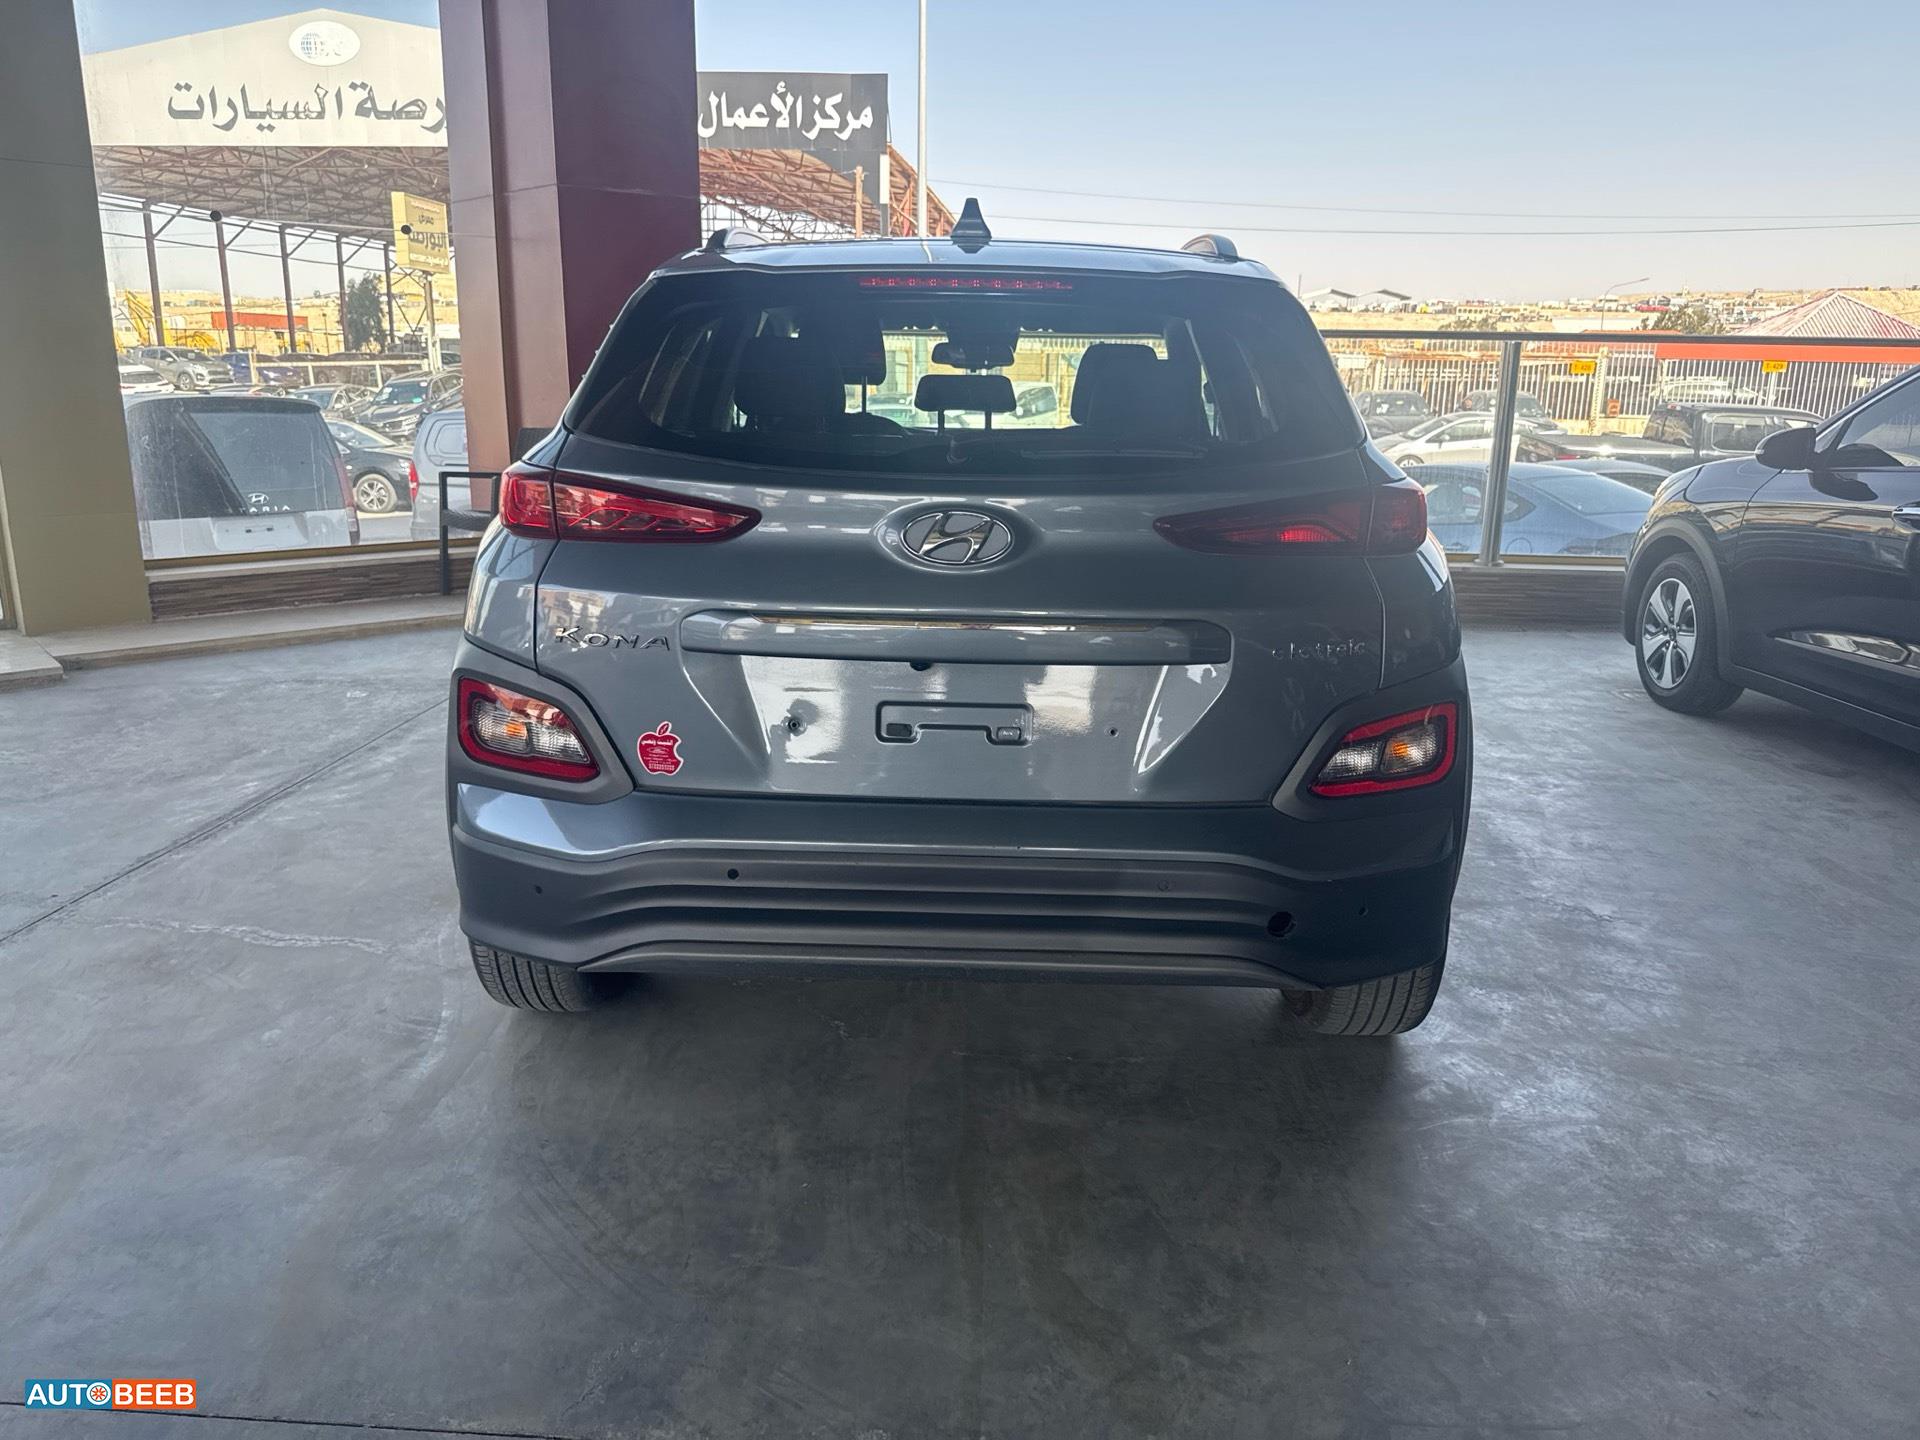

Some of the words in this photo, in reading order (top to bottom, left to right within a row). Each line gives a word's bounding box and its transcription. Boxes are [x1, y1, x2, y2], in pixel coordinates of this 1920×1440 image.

[168, 83, 343, 133] السيارات
[348, 81, 446, 133] رصة
[697, 80, 802, 138] الأعمال
[802, 92, 873, 140] مركز
[555, 625, 671, 651] KONA
